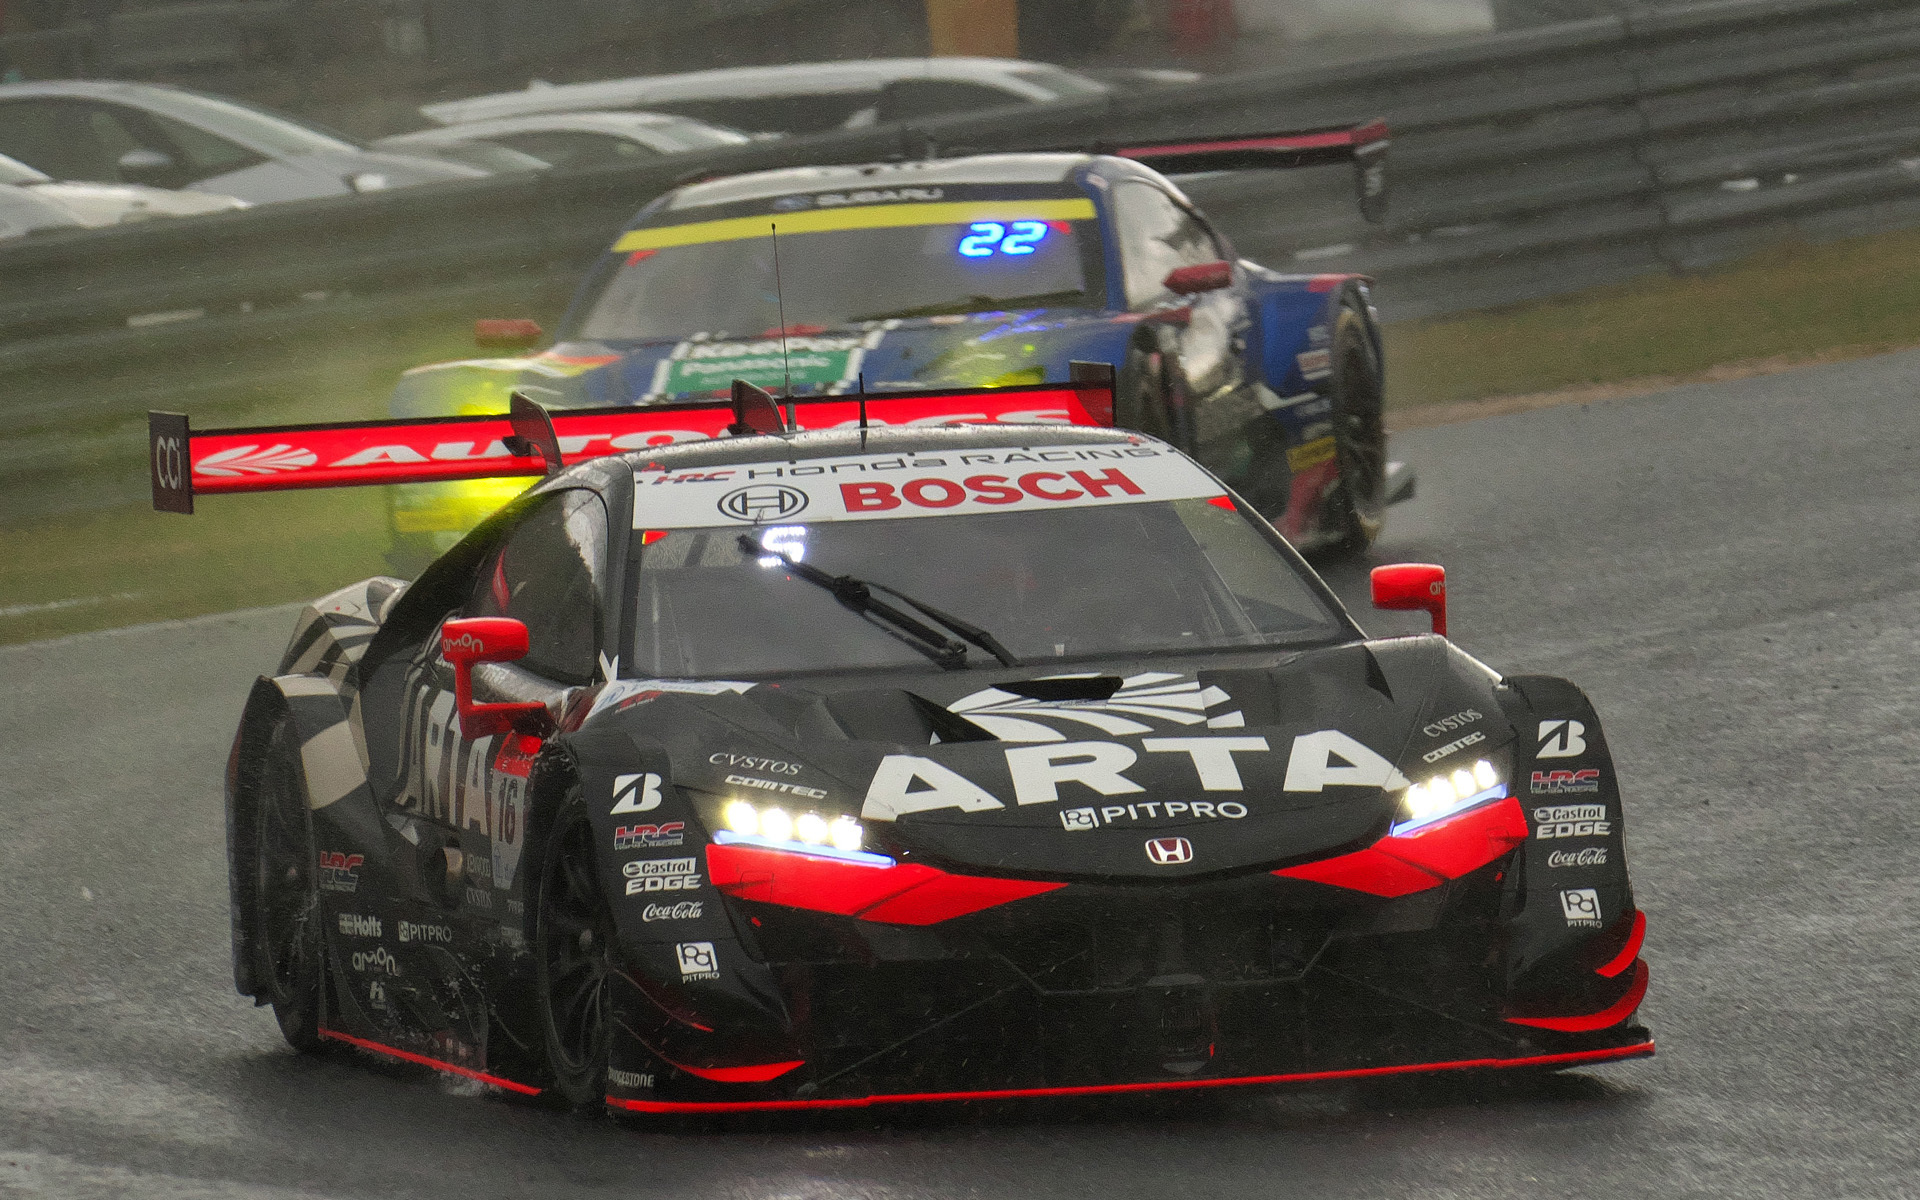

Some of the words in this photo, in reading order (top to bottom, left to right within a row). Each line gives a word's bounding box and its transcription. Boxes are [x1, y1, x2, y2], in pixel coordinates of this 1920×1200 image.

[958, 221, 1048, 258] 22
[747, 457, 948, 480] Honda
[959, 449, 1162, 466] RACING
[838, 467, 1147, 514] BOSCH
[1422, 708, 1484, 738] CVSTOS
[1422, 730, 1486, 764] COMTEC
[708, 751, 803, 776] CVSTOS
[724, 774, 828, 800] COMTEC
[860, 728, 1412, 823] ARTA
[1530, 768, 1600, 790] HRC
[498, 776, 518, 846] 16
[1101, 801, 1248, 824] PITPRO
[1551, 806, 1602, 821] Castrol
[614, 821, 685, 847] HRC
[1536, 821, 1611, 840] EDGE
[641, 858, 693, 874] Castrol
[1548, 847, 1608, 868] Coca-Cola
[625, 874, 702, 896] EDGE
[642, 901, 704, 923] Coca-Cola
[1566, 918, 1603, 929] PITPRO
[353, 914, 382, 938] Holts
[409, 922, 453, 943] PITPRO
[682, 971, 720, 984] PITPRO
